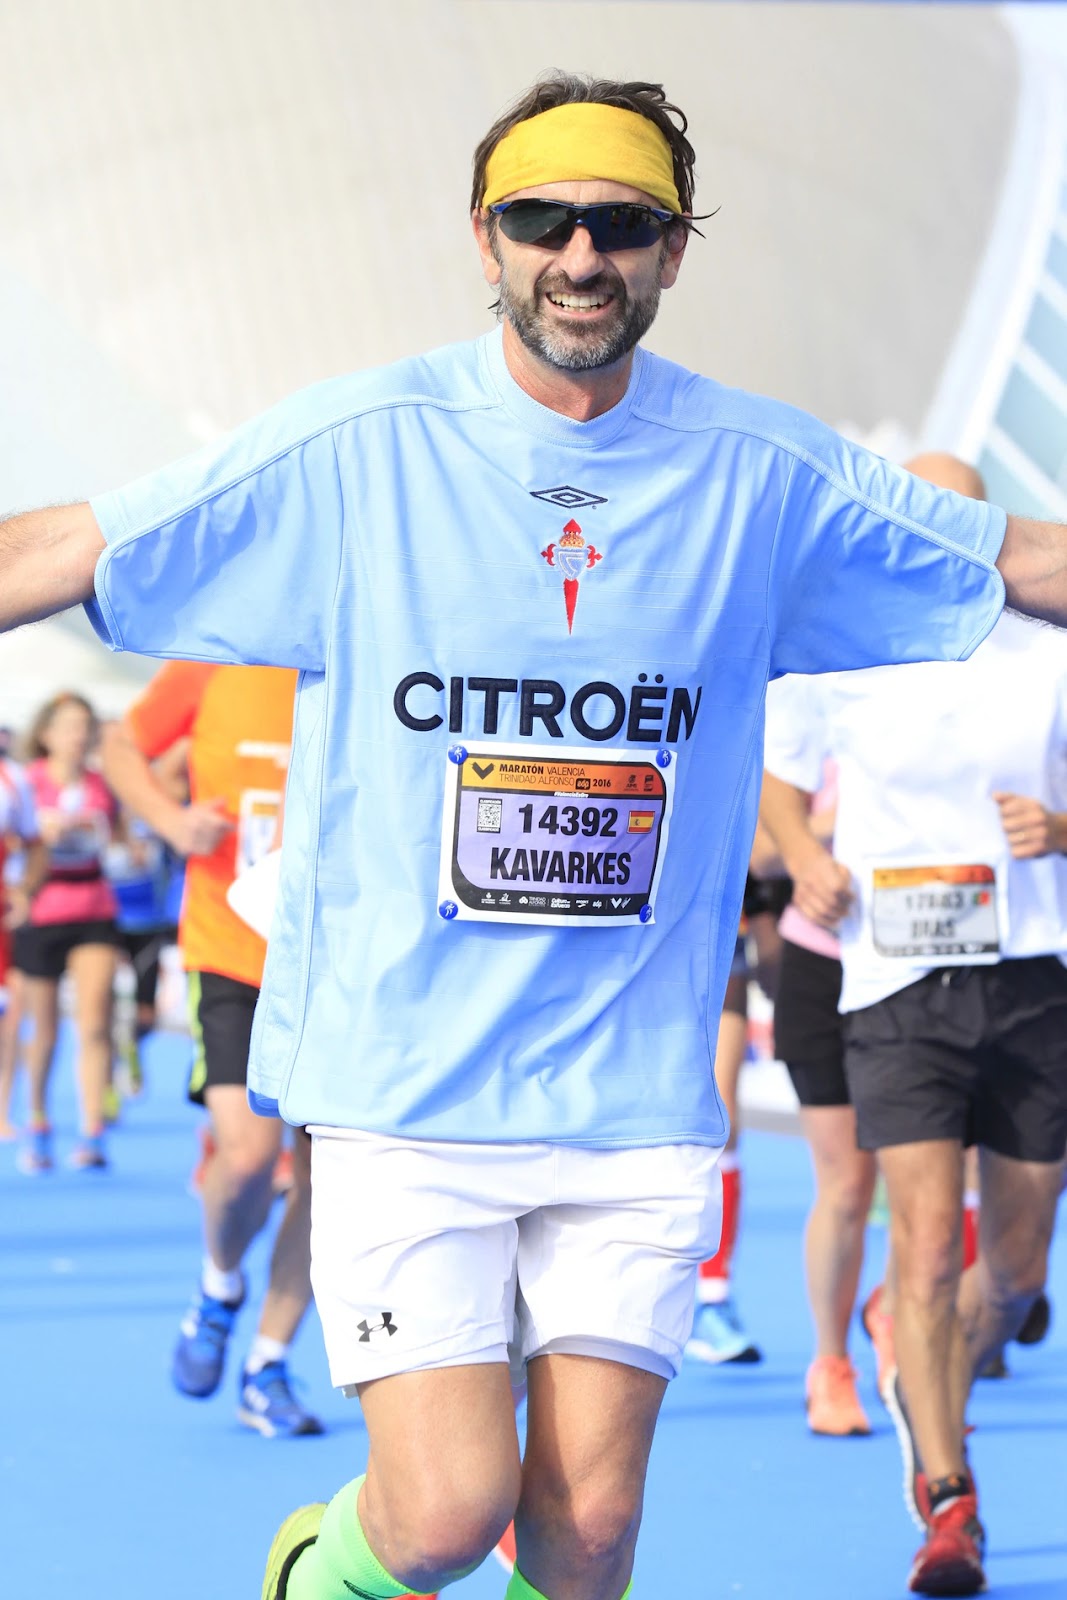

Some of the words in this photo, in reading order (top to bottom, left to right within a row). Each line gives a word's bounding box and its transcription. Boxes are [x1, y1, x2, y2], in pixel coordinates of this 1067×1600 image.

[393, 671, 702, 743] CITROËN
[499, 763, 544, 775] MARATÓN
[547, 766, 585, 777] VALENCIA
[499, 773, 536, 784] TRINIDAD
[538, 776, 574, 786] ALFONSO
[593, 778, 612, 788] 2016
[518, 803, 618, 837] 14392
[490, 847, 631, 885] KAVARKES
